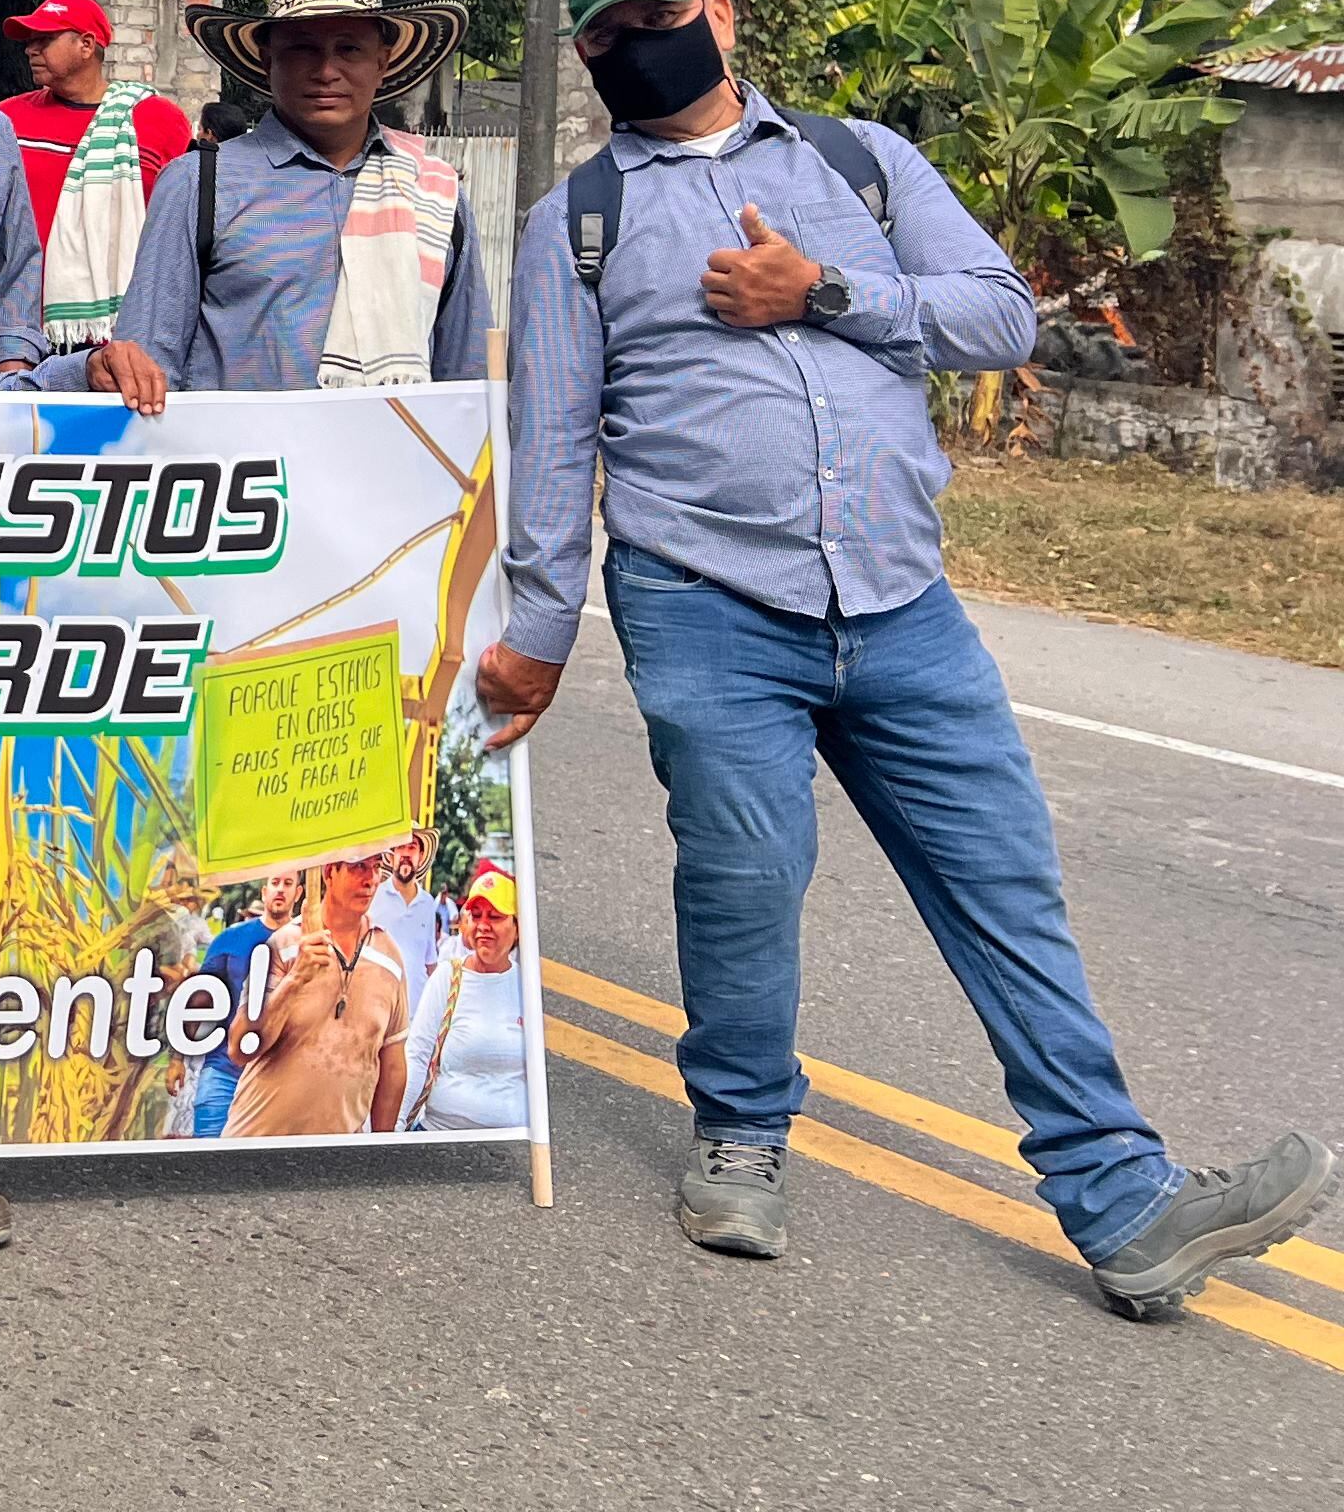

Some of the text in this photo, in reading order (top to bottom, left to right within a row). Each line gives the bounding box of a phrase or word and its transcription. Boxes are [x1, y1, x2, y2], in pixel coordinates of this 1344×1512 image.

[229, 653, 381, 716] PORQUE ESTAMOS
[276, 699, 355, 740] EN CRISIS
[231, 748, 280, 775] BAJOS
[291, 733, 349, 765] PRECIOS
[360, 725, 383, 751] QUE
[256, 757, 366, 797] NOS PAGA LA
